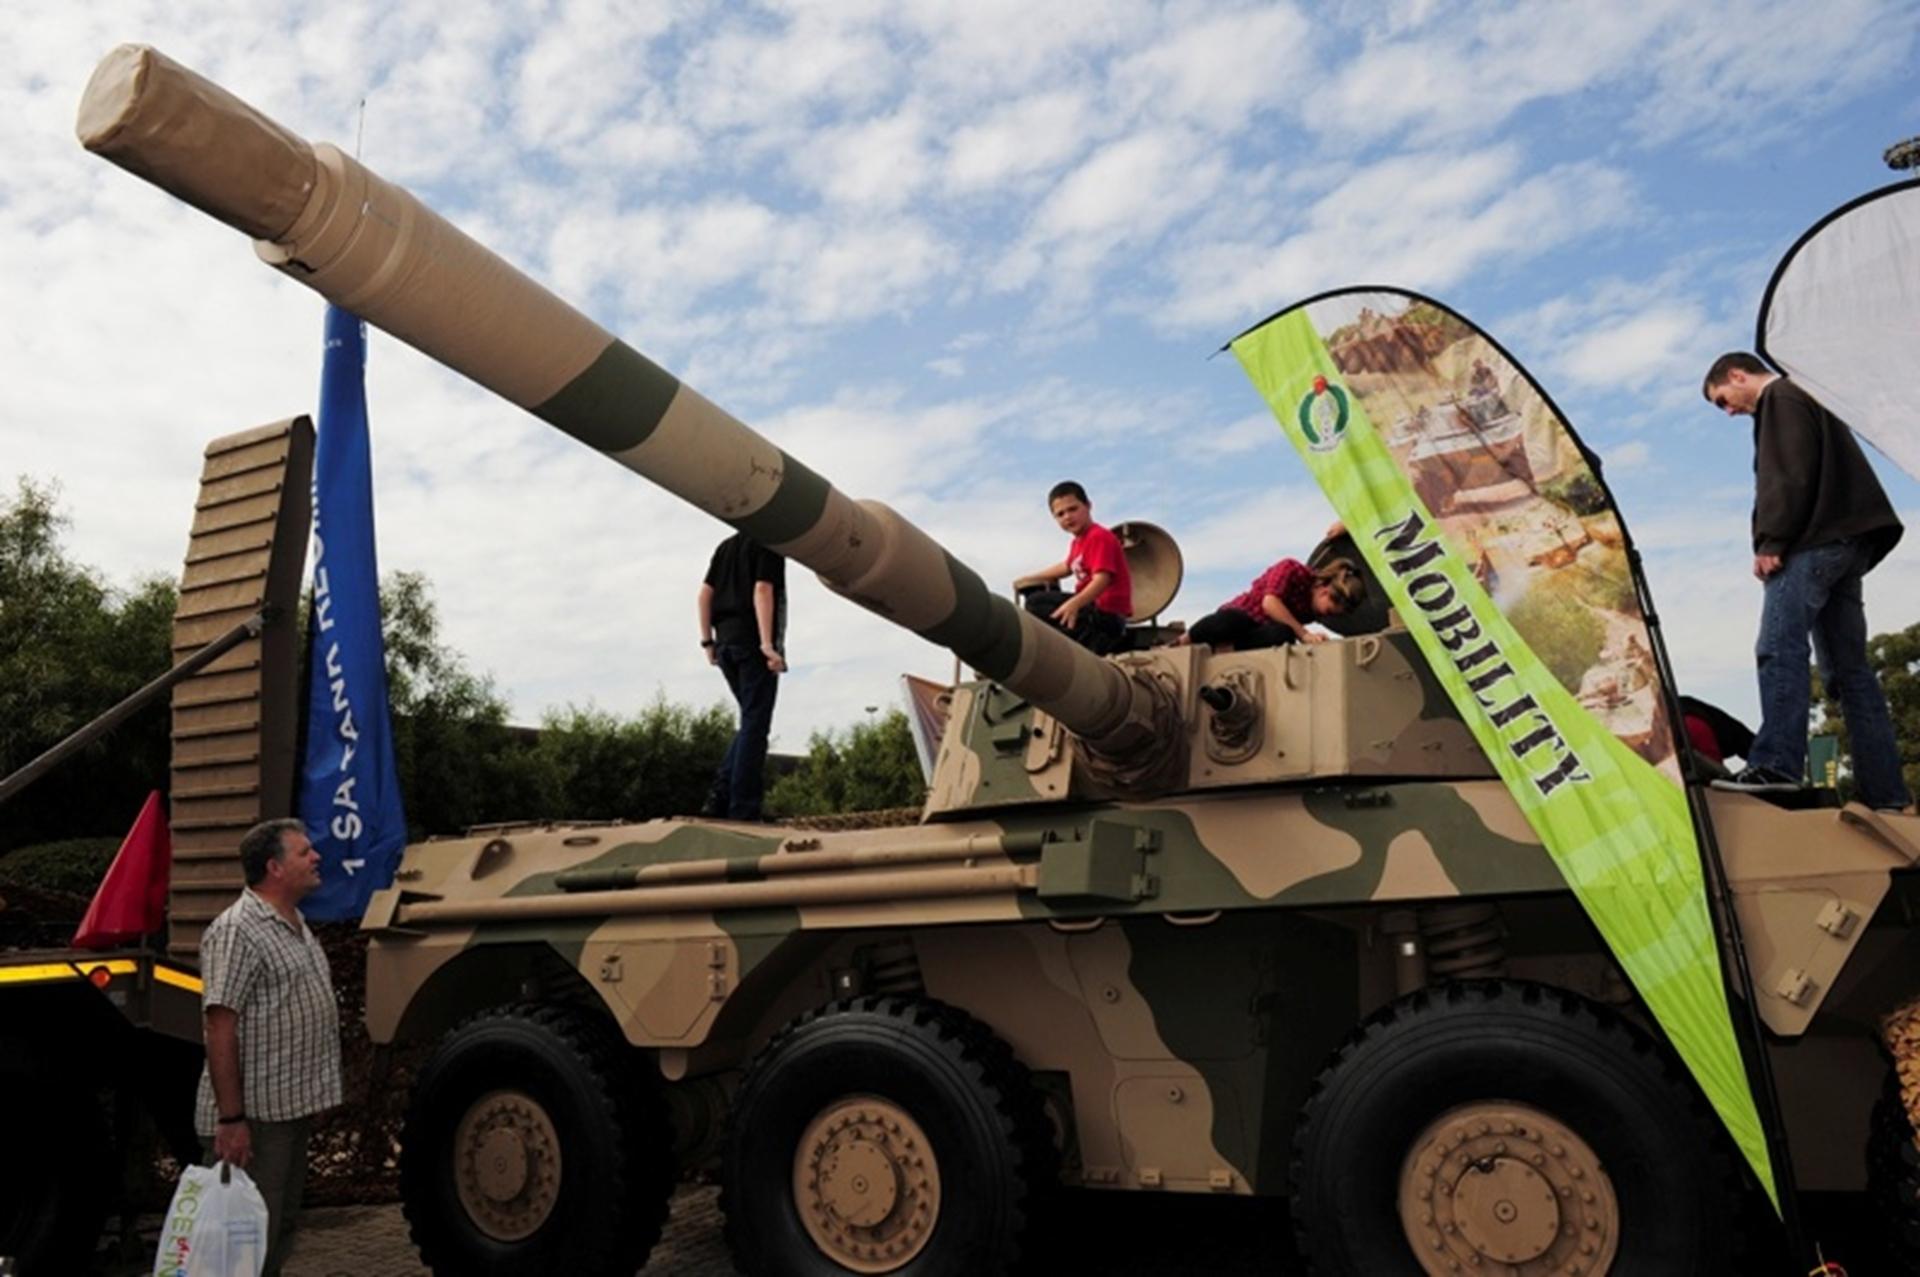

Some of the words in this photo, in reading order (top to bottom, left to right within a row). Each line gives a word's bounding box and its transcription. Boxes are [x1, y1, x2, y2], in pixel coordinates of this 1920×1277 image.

[1374, 508, 1592, 797] MOBILITY
[331, 776, 362, 841] SA
[342, 857, 366, 877] 1
